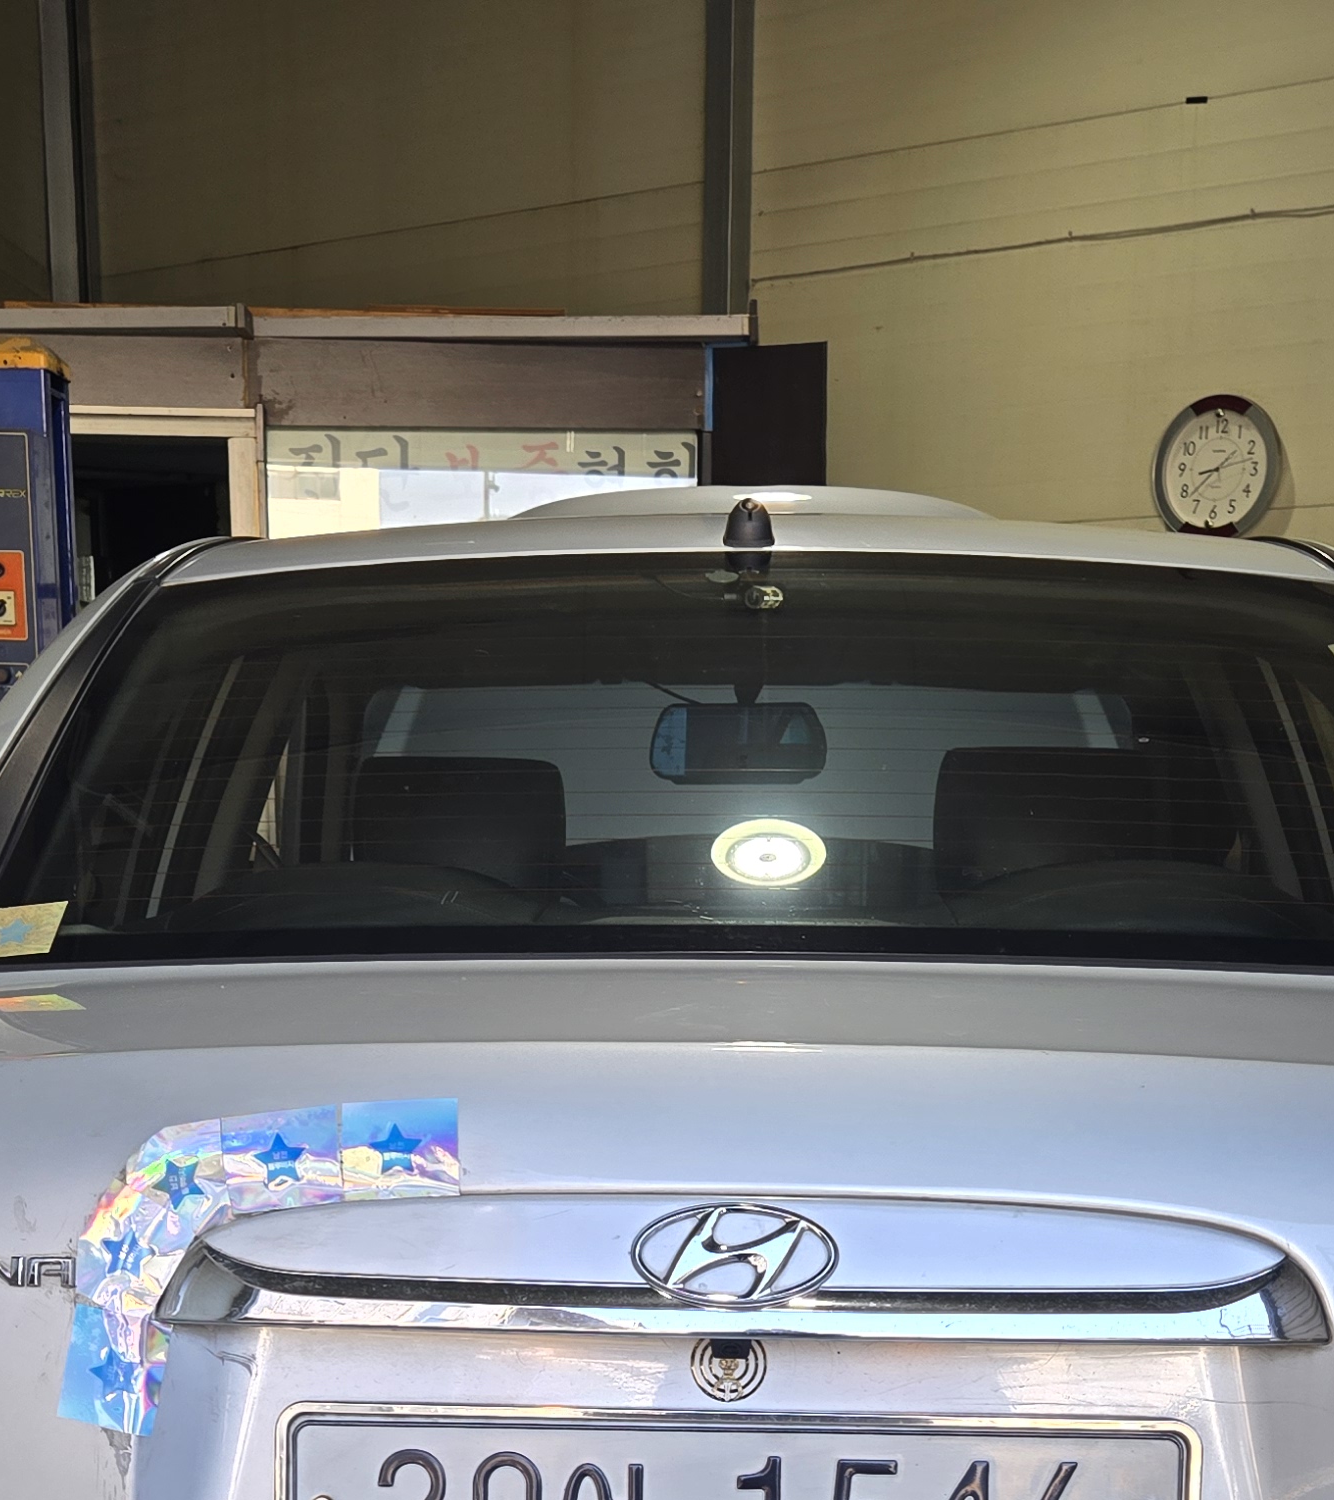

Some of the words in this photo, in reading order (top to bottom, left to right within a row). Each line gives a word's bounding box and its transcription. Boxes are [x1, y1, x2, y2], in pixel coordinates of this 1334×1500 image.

[1199, 426, 1209, 440] 11
[1216, 418, 1229, 434] 12
[1238, 425, 1243, 439] 1
[1183, 441, 1196, 456] 10
[1247, 440, 1256, 455] 2
[1178, 462, 1187, 478] 9
[1250, 461, 1259, 477] 3
[1180, 483, 1189, 498] 8
[1242, 483, 1252, 498] 4
[1192, 499, 1201, 514] 7
[1209, 505, 1218, 520] 6
[1227, 499, 1237, 514] 5
